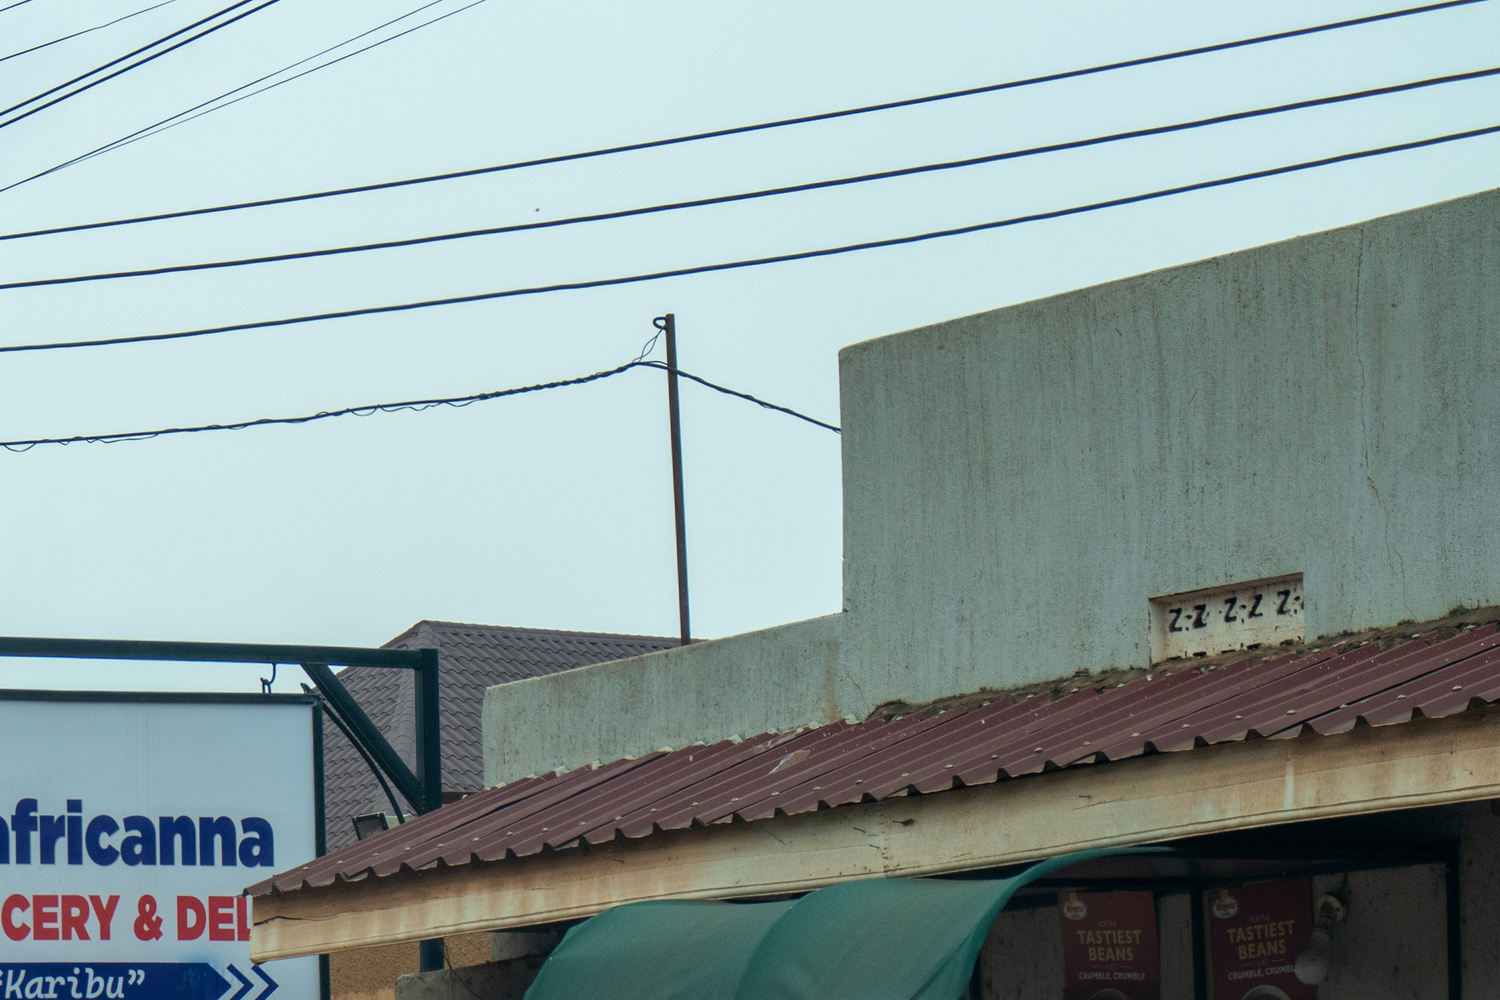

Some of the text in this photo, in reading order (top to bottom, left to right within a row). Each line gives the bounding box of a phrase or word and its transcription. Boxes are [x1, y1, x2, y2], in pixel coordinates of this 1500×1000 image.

[134, 894, 164, 941] &
[176, 895, 251, 941] DEL
[1077, 929, 1143, 945] TASTIEST
[1226, 920, 1296, 944] TASTIEST
[1088, 947, 1135, 962] BEANS
[1238, 939, 1288, 960] BEANS
[1265, 964, 1296, 977] CRUMBL
